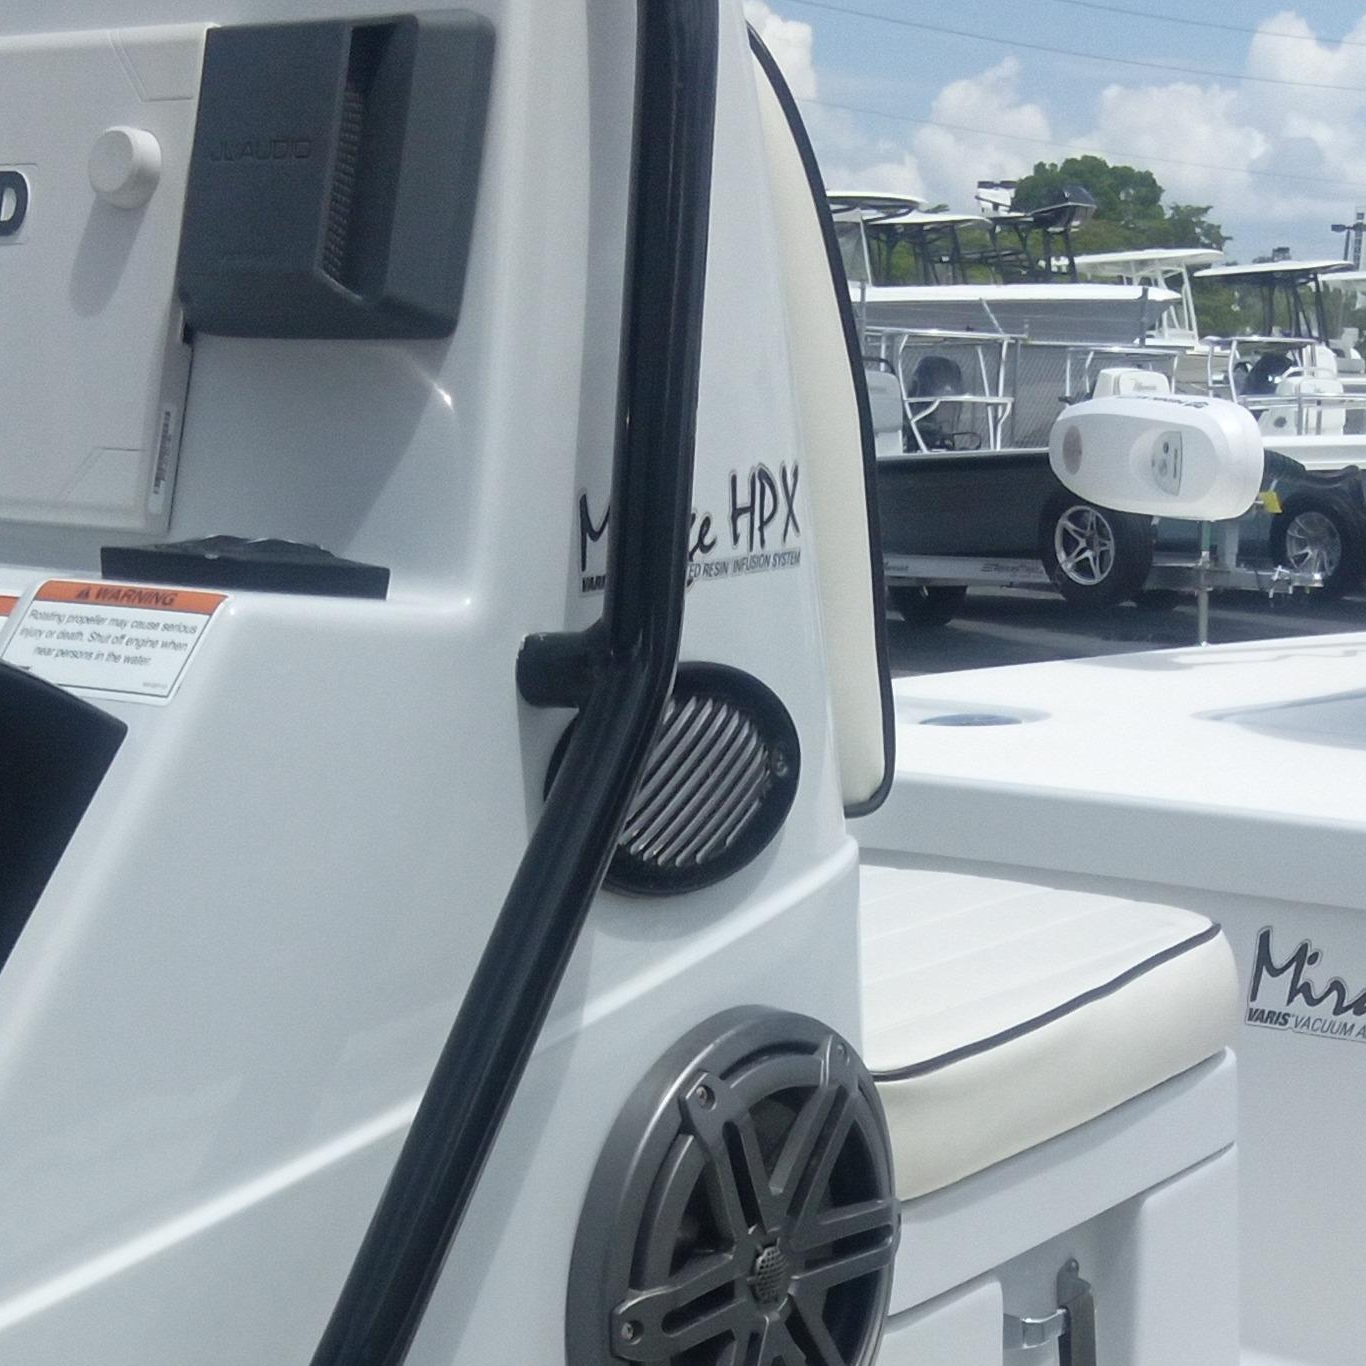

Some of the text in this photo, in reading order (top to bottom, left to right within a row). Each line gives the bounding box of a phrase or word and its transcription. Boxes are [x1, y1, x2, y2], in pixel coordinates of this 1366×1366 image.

[238, 139, 311, 160] AUDIO
[730, 464, 800, 552] HPX
[94, 587, 179, 606] WARNING
[28, 609, 198, 634] Rotating propeller may cause serious
[19, 627, 43, 640] injury
[45, 629, 54, 640] or
[87, 631, 111, 644] Shut
[111, 633, 126, 646] off
[125, 635, 160, 651] engine
[160, 639, 189, 652] when
[34, 646, 55, 656] near
[54, 647, 94, 661] persons
[95, 649, 105, 661] in
[106, 650, 122, 664] the
[1247, 1007, 1291, 1026] VARIS
[1293, 1015, 1356, 1037] VACUUM
